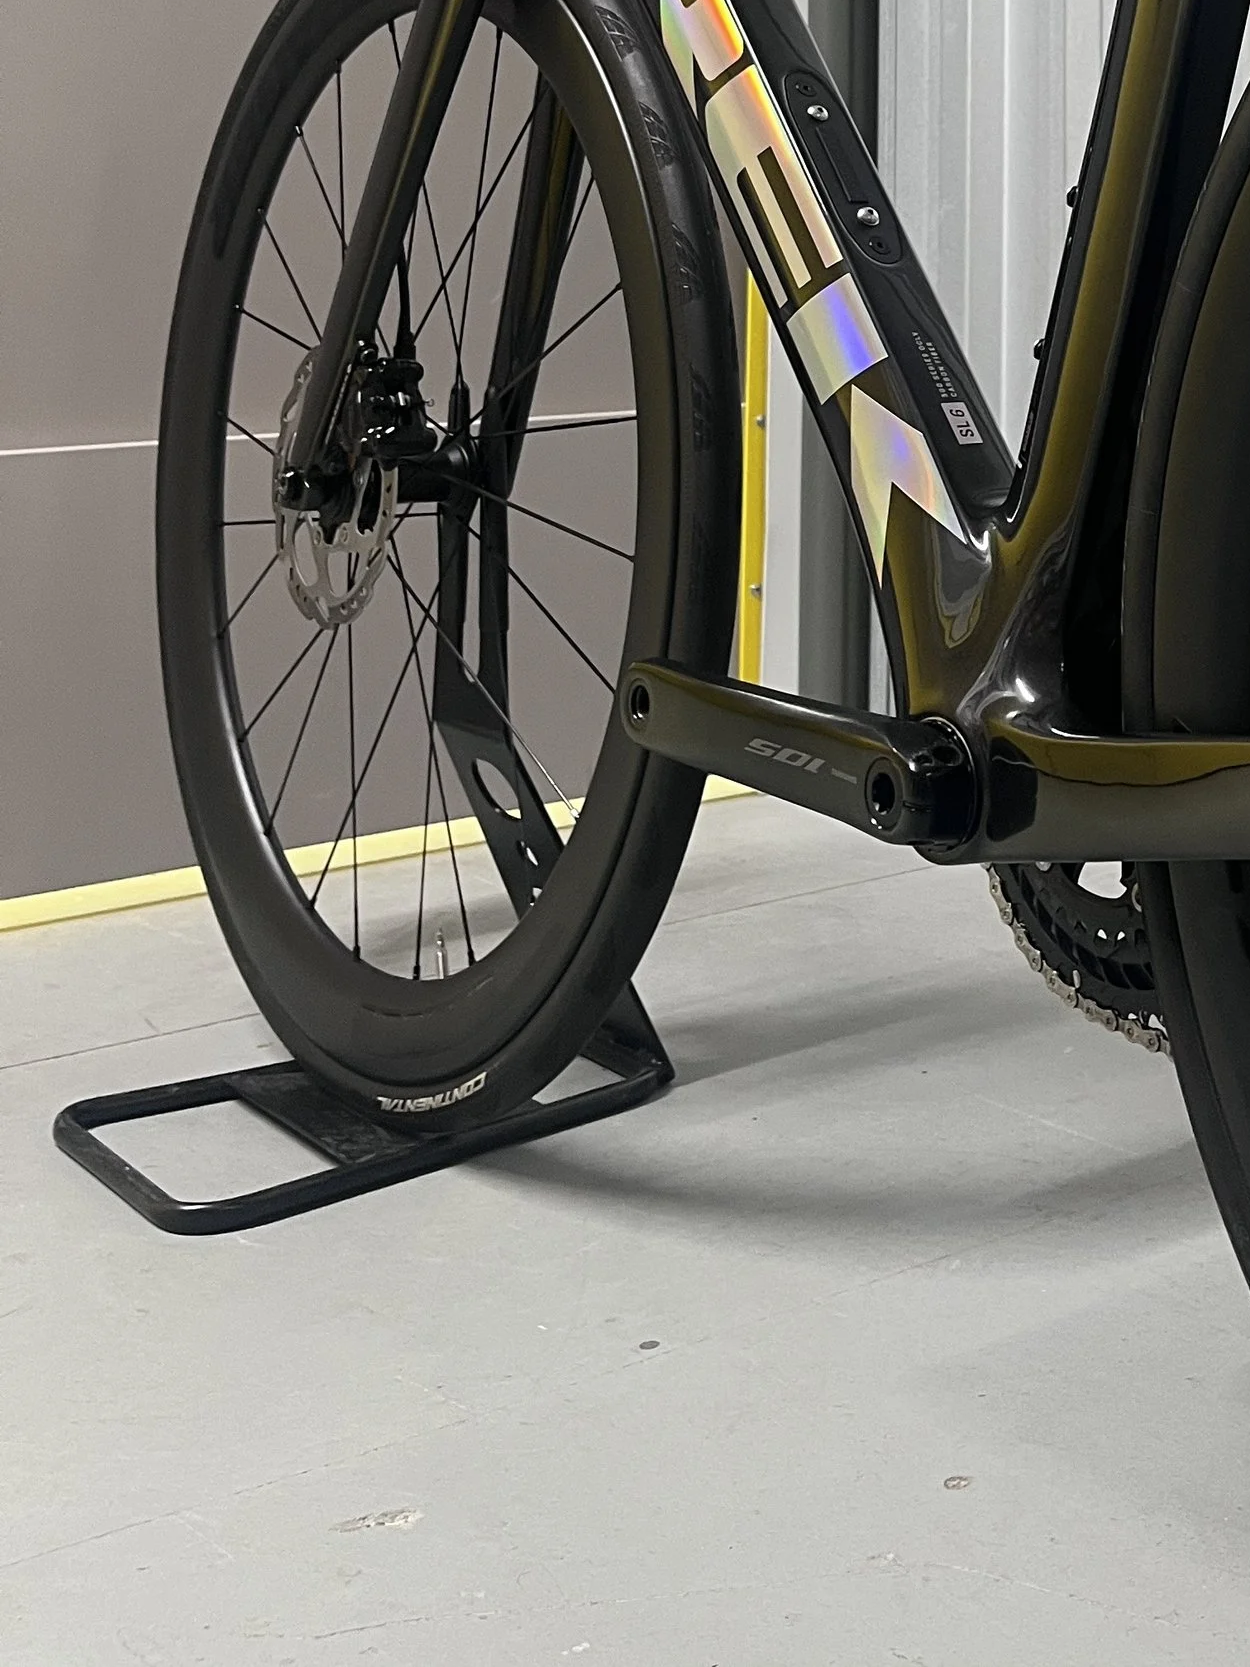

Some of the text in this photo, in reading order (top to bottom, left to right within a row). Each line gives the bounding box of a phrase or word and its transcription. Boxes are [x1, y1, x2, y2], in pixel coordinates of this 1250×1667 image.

[938, 366, 958, 398] CARBON
[949, 408, 975, 438] SL 6
[744, 738, 826, 774] 105
[377, 1071, 488, 1113] CONTINENTAL
